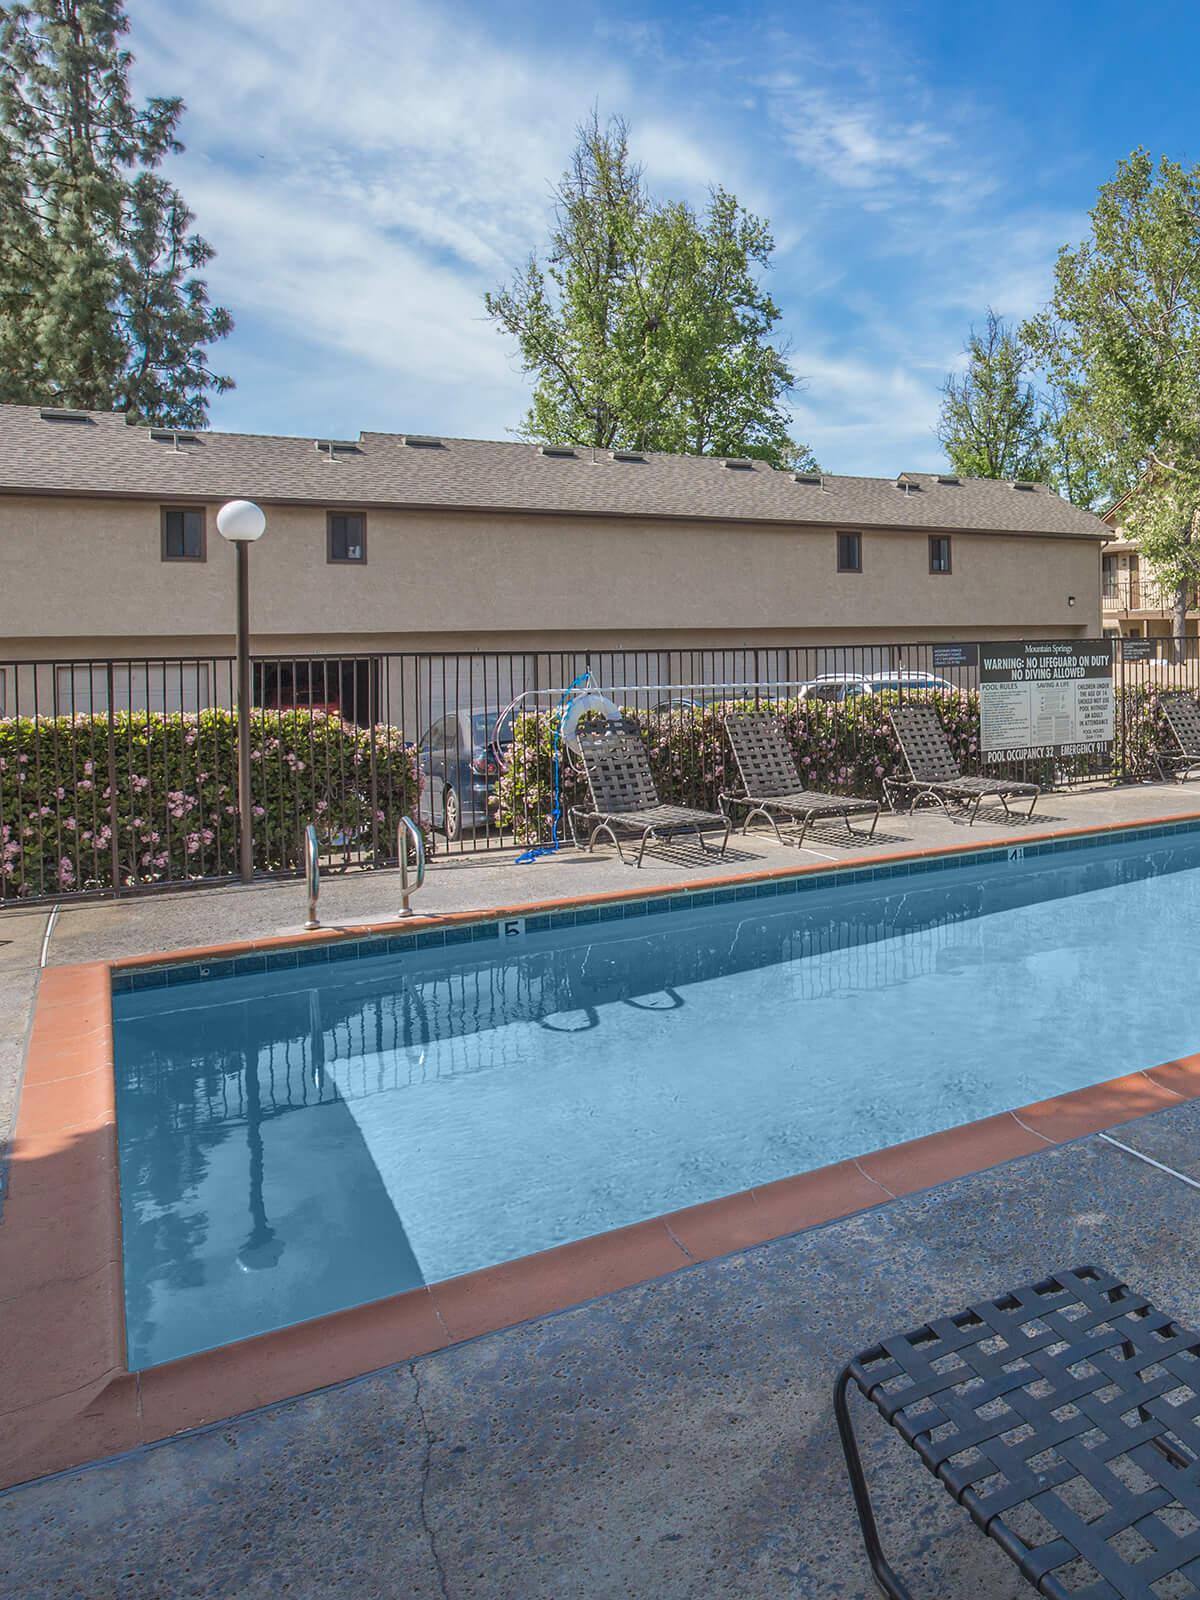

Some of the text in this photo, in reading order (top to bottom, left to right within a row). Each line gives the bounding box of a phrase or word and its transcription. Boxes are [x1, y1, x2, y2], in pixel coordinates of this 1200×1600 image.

[1024, 644, 1073, 654] Mountain Springs
[983, 655, 1109, 670] WARNING: NO LIFEGUARD ON DUTY
[1012, 667, 1086, 680] NO DIVING ALLOWED
[987, 741, 1107, 763] POOL OCCUPANCY 32 EMERGENCY 911
[504, 920, 520, 936] 5
